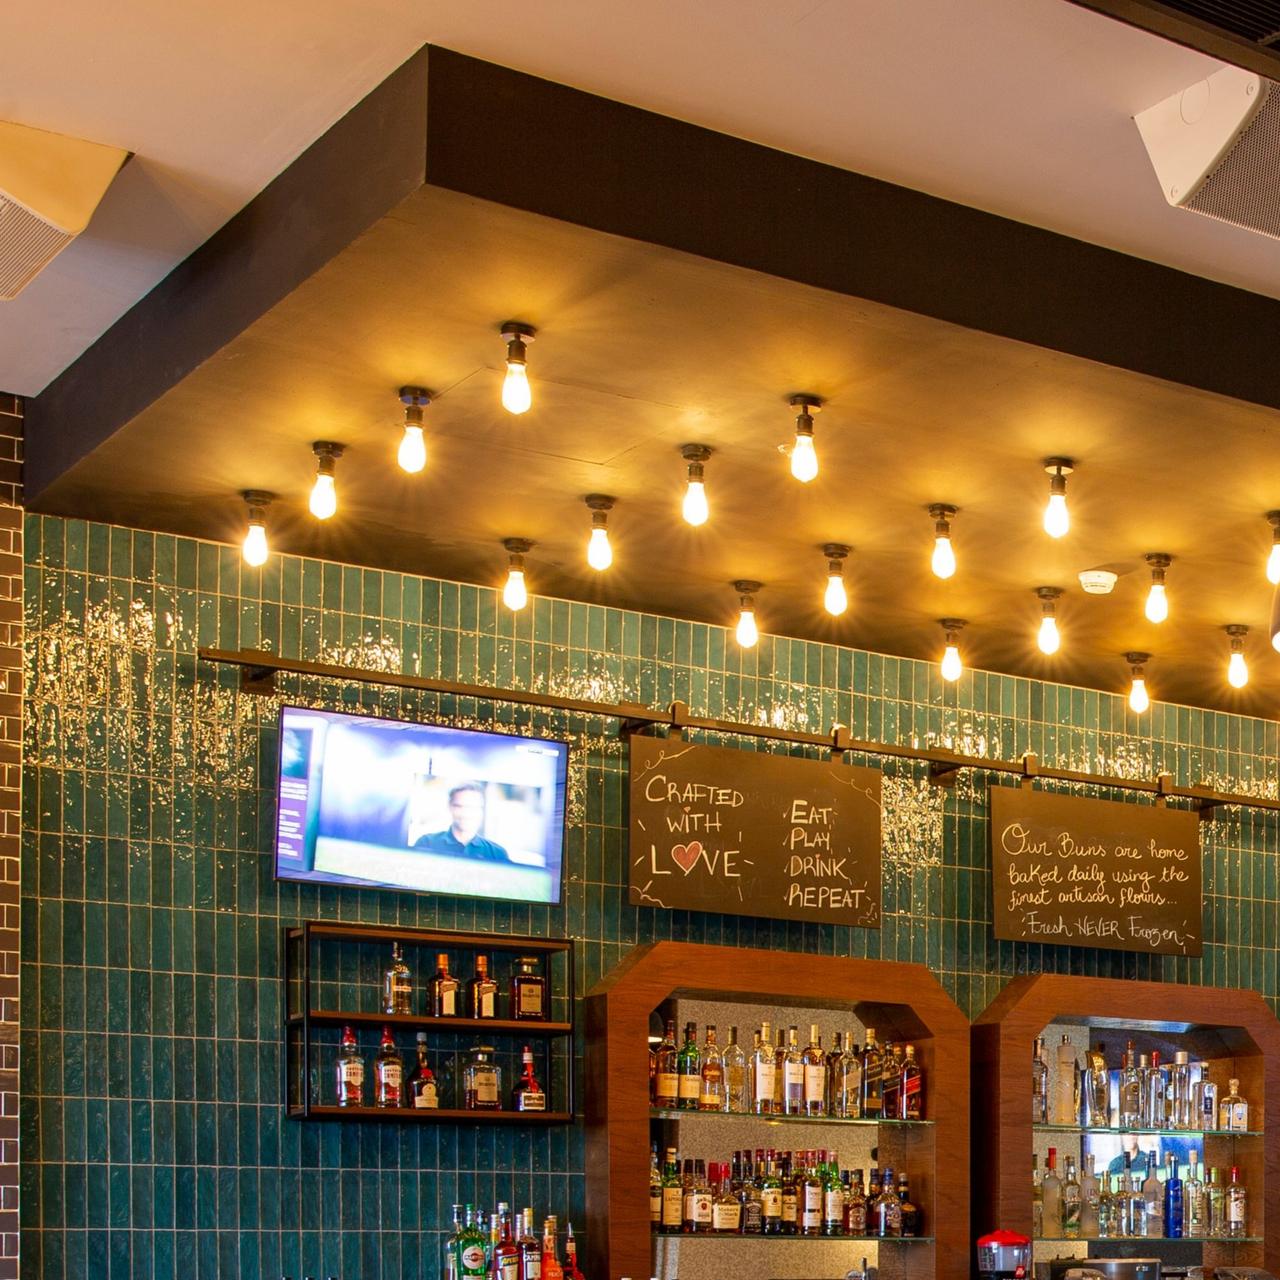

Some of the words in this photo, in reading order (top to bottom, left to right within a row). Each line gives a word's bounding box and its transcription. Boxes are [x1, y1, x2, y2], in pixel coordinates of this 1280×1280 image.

[645, 775, 744, 807] CRAFTED
[666, 807, 722, 833] WITH
[790, 800, 832, 825] EAT
[790, 827, 831, 850] PLAY
[1001, 823, 1052, 856] Our
[1057, 832, 1107, 858] Buns
[1114, 846, 1143, 859] are
[1147, 839, 1189, 860] home
[790, 854, 849, 880] DRINK
[1067, 864, 1105, 894] daily
[1112, 869, 1156, 893] using
[1158, 866, 1189, 883] the
[789, 883, 866, 909] REPEAT
[1007, 888, 1052, 911] finest
[1058, 886, 1115, 905] artisan
[1026, 911, 1073, 937] Fresh
[1073, 915, 1125, 940] NEVER
[1128, 916, 1184, 947] Frozen
